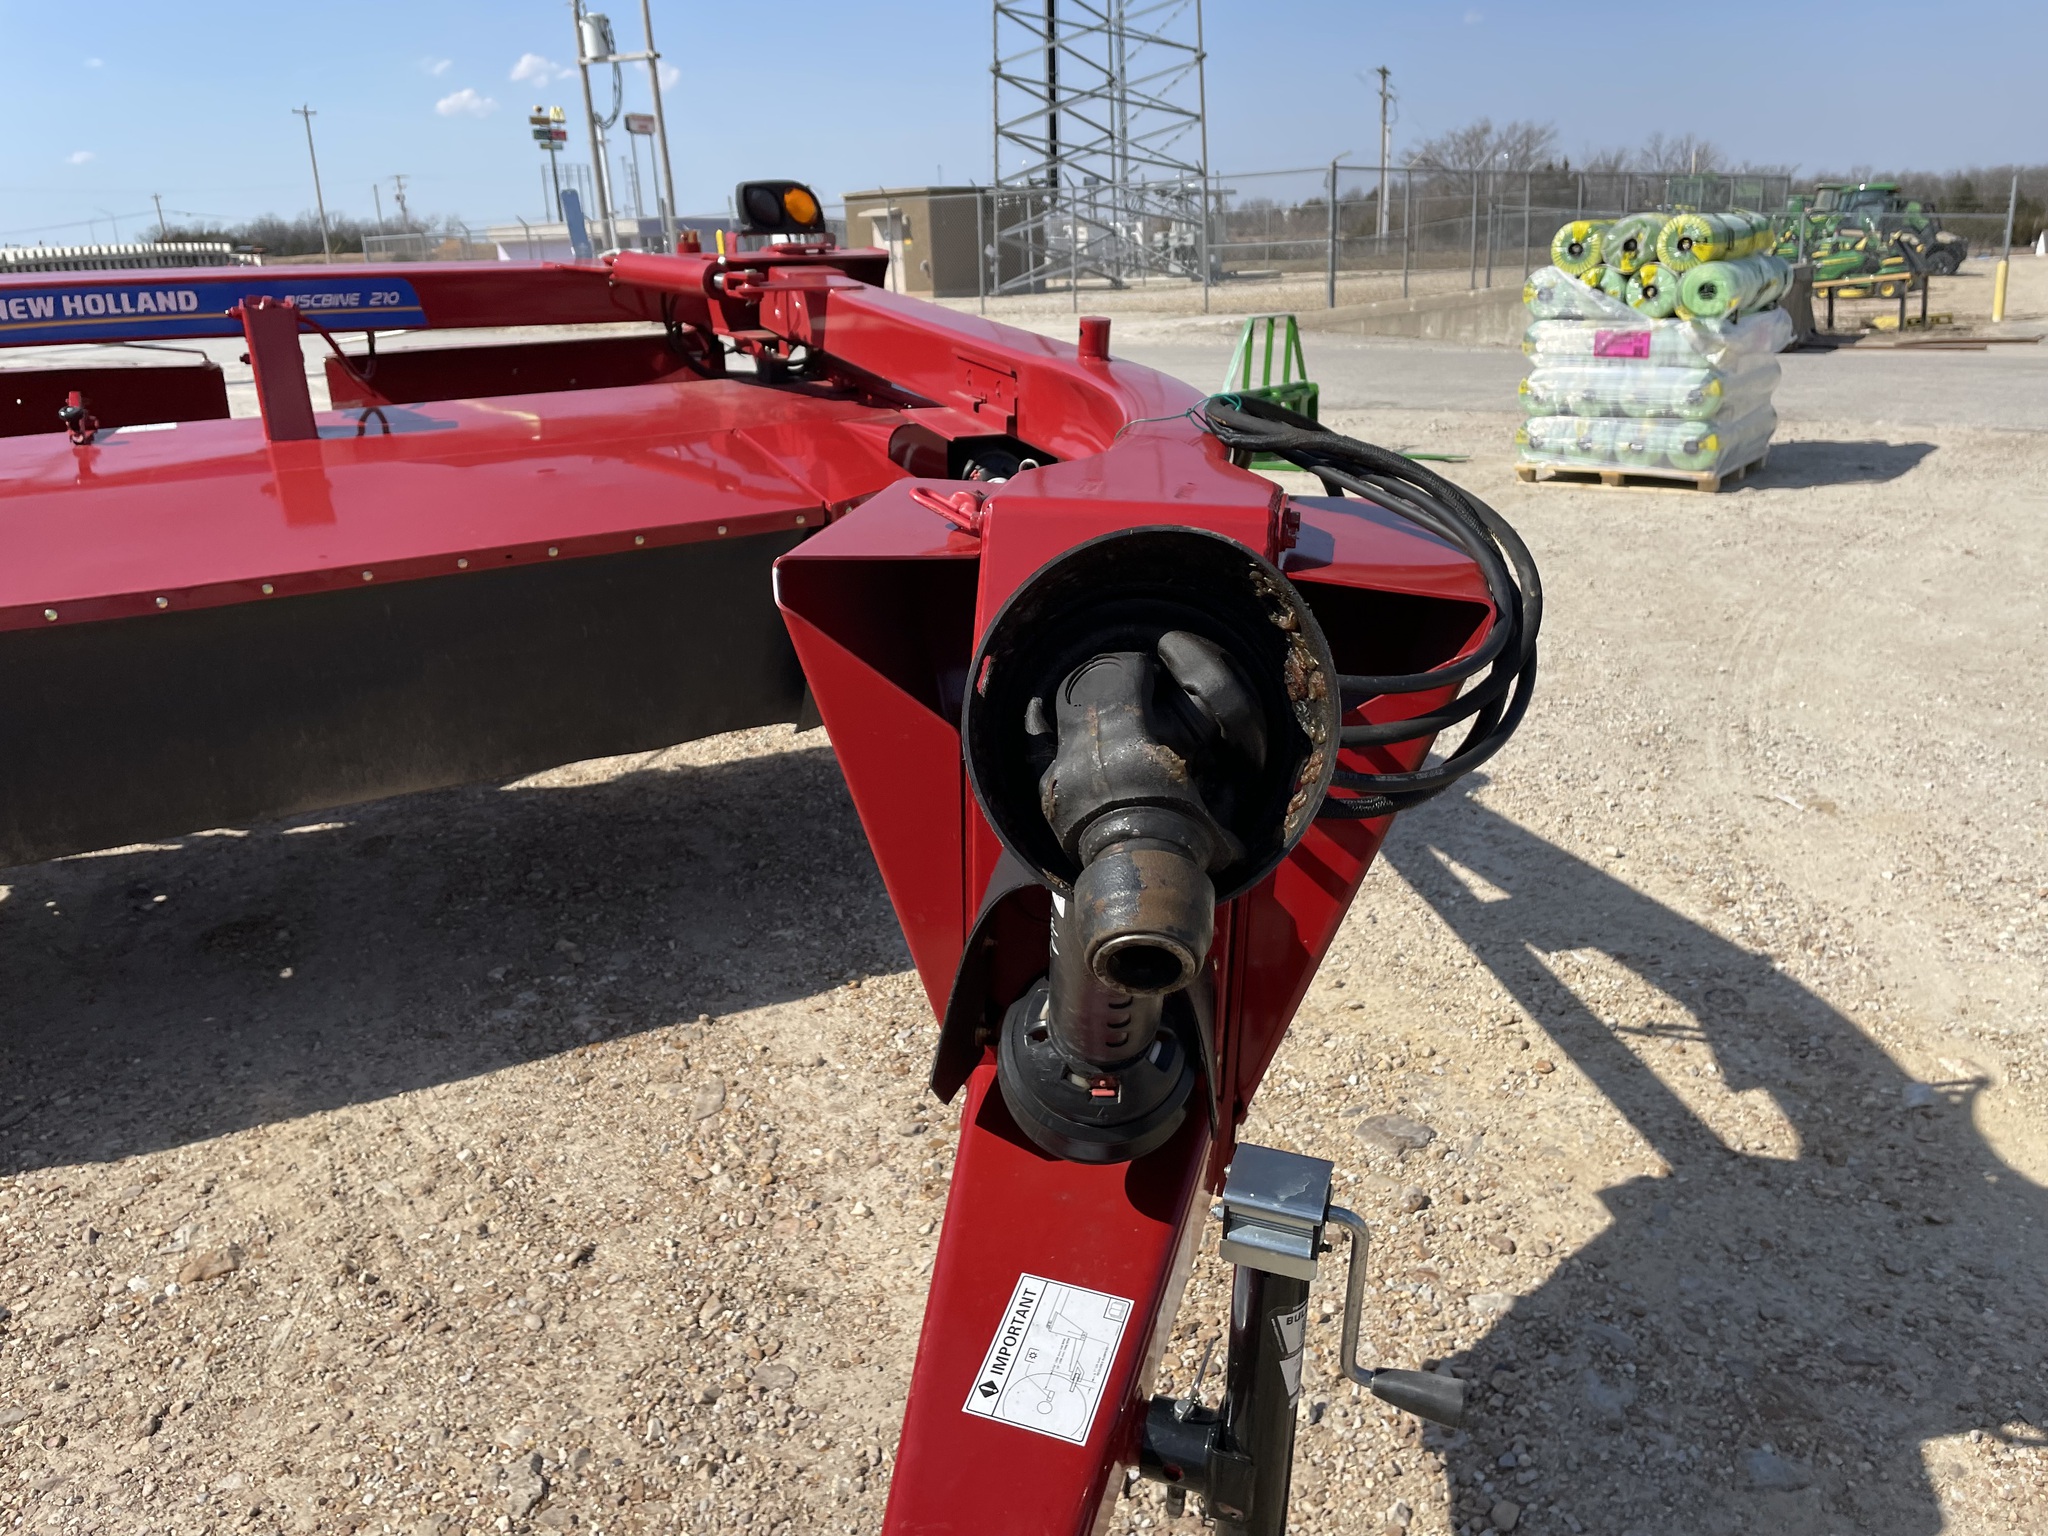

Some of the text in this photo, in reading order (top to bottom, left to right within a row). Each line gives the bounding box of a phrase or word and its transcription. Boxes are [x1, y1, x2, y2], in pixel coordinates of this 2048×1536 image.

[62, 290, 198, 316] HOLLAND
[369, 291, 400, 306] 210
[990, 1288, 1037, 1375] IMPORTANT
